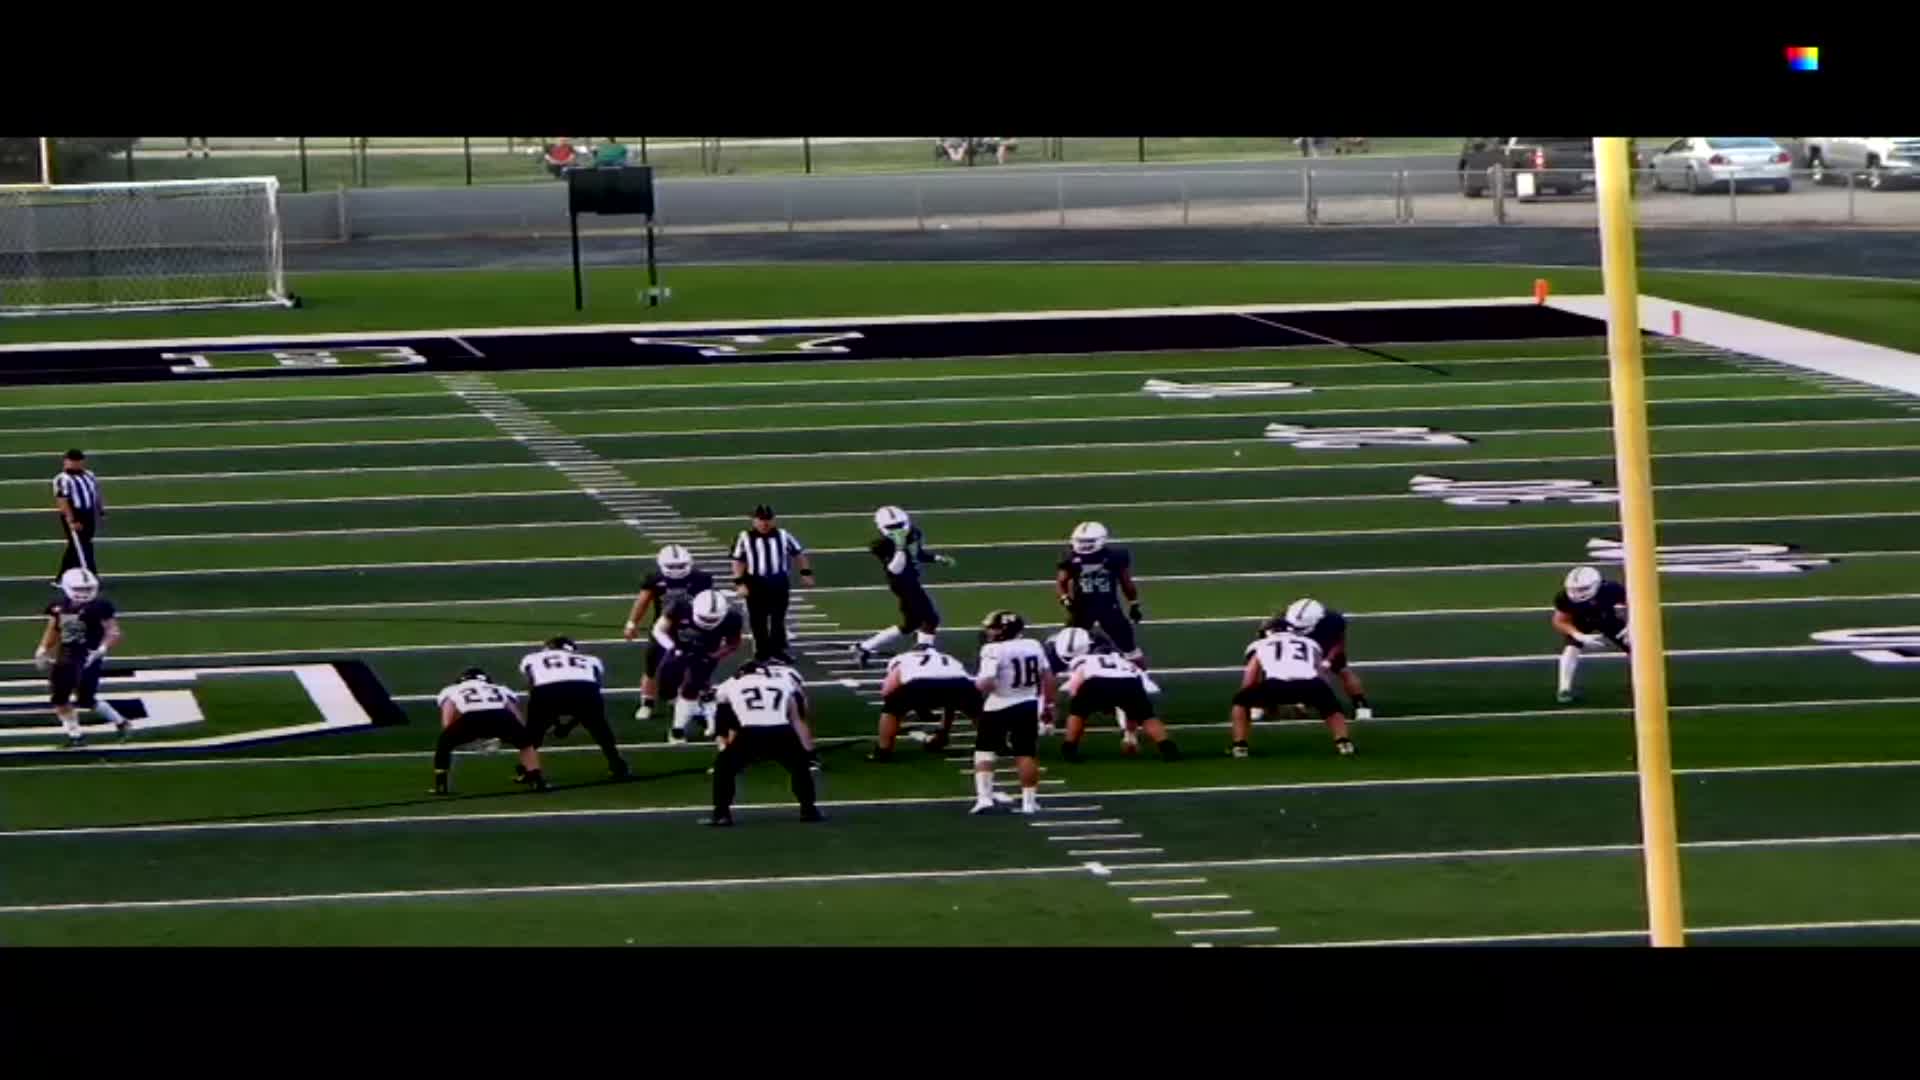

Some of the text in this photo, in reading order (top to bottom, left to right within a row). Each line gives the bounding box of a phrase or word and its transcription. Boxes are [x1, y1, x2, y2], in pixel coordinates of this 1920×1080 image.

[1266, 640, 1308, 662] 73
[1011, 655, 1040, 688] 18
[460, 686, 504, 704] 23
[741, 686, 783, 711] 27
